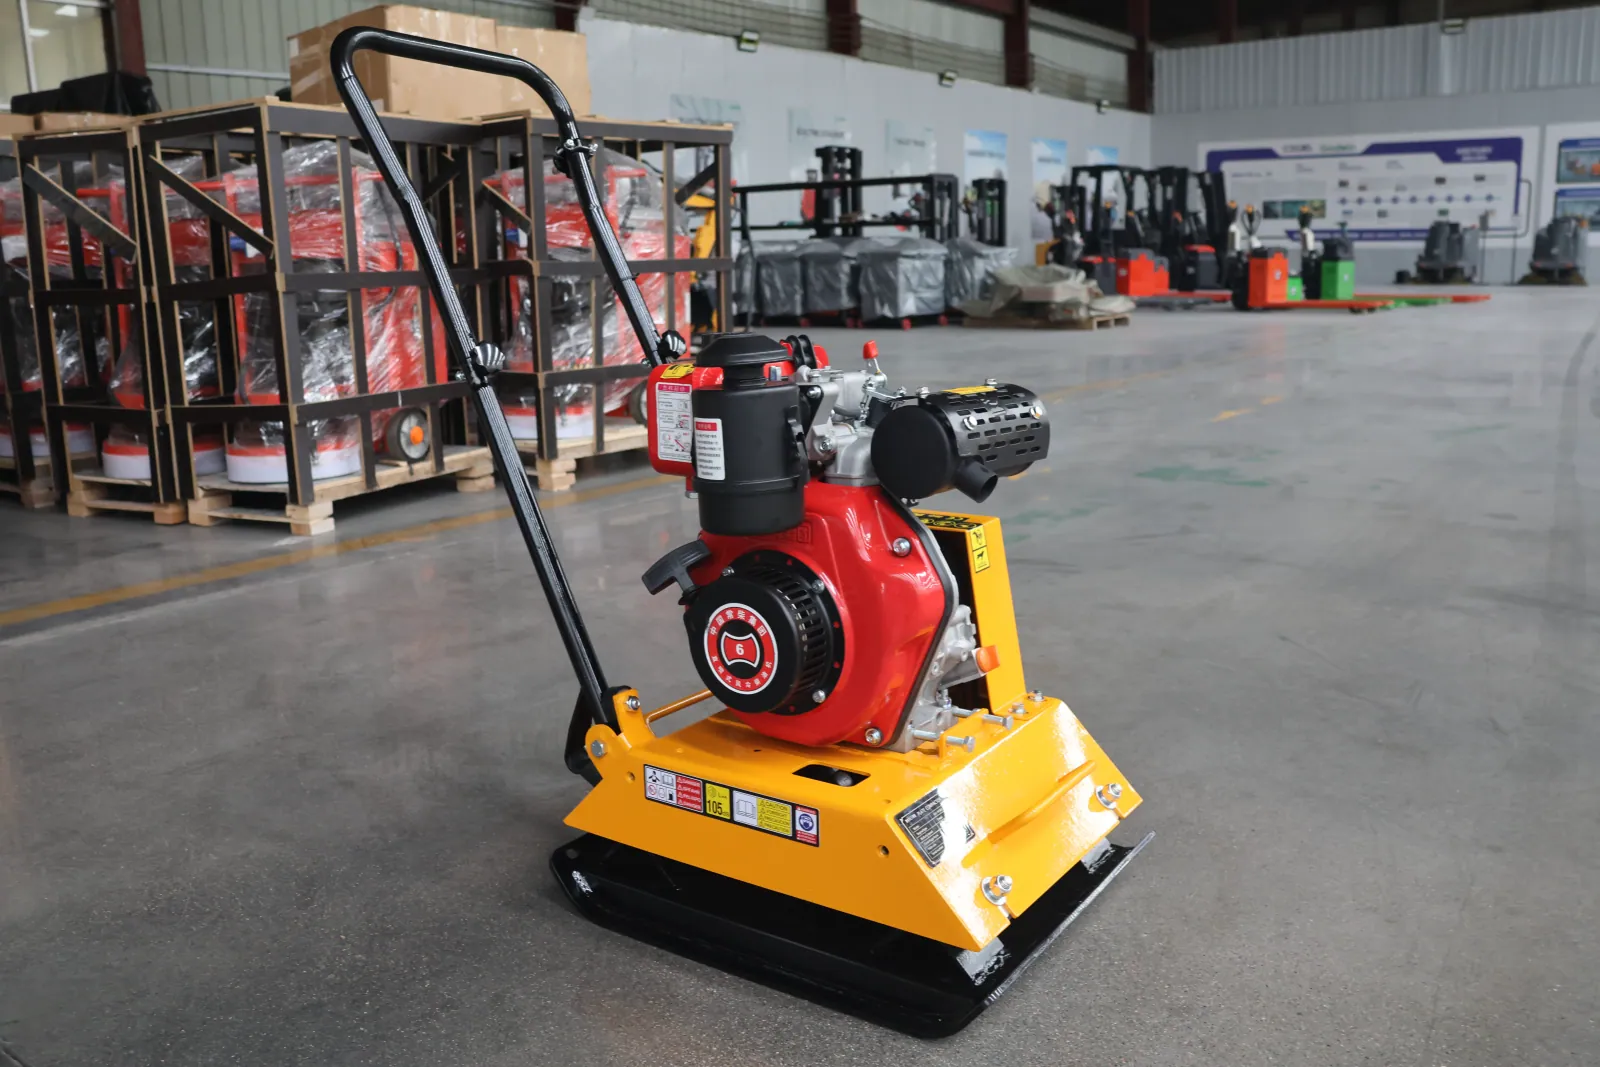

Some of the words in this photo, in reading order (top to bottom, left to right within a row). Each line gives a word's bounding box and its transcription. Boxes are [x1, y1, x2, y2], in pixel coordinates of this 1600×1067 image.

[709, 609, 768, 637] 中国常柴集团
[735, 643, 745, 656] 6
[707, 800, 723, 815] 105
